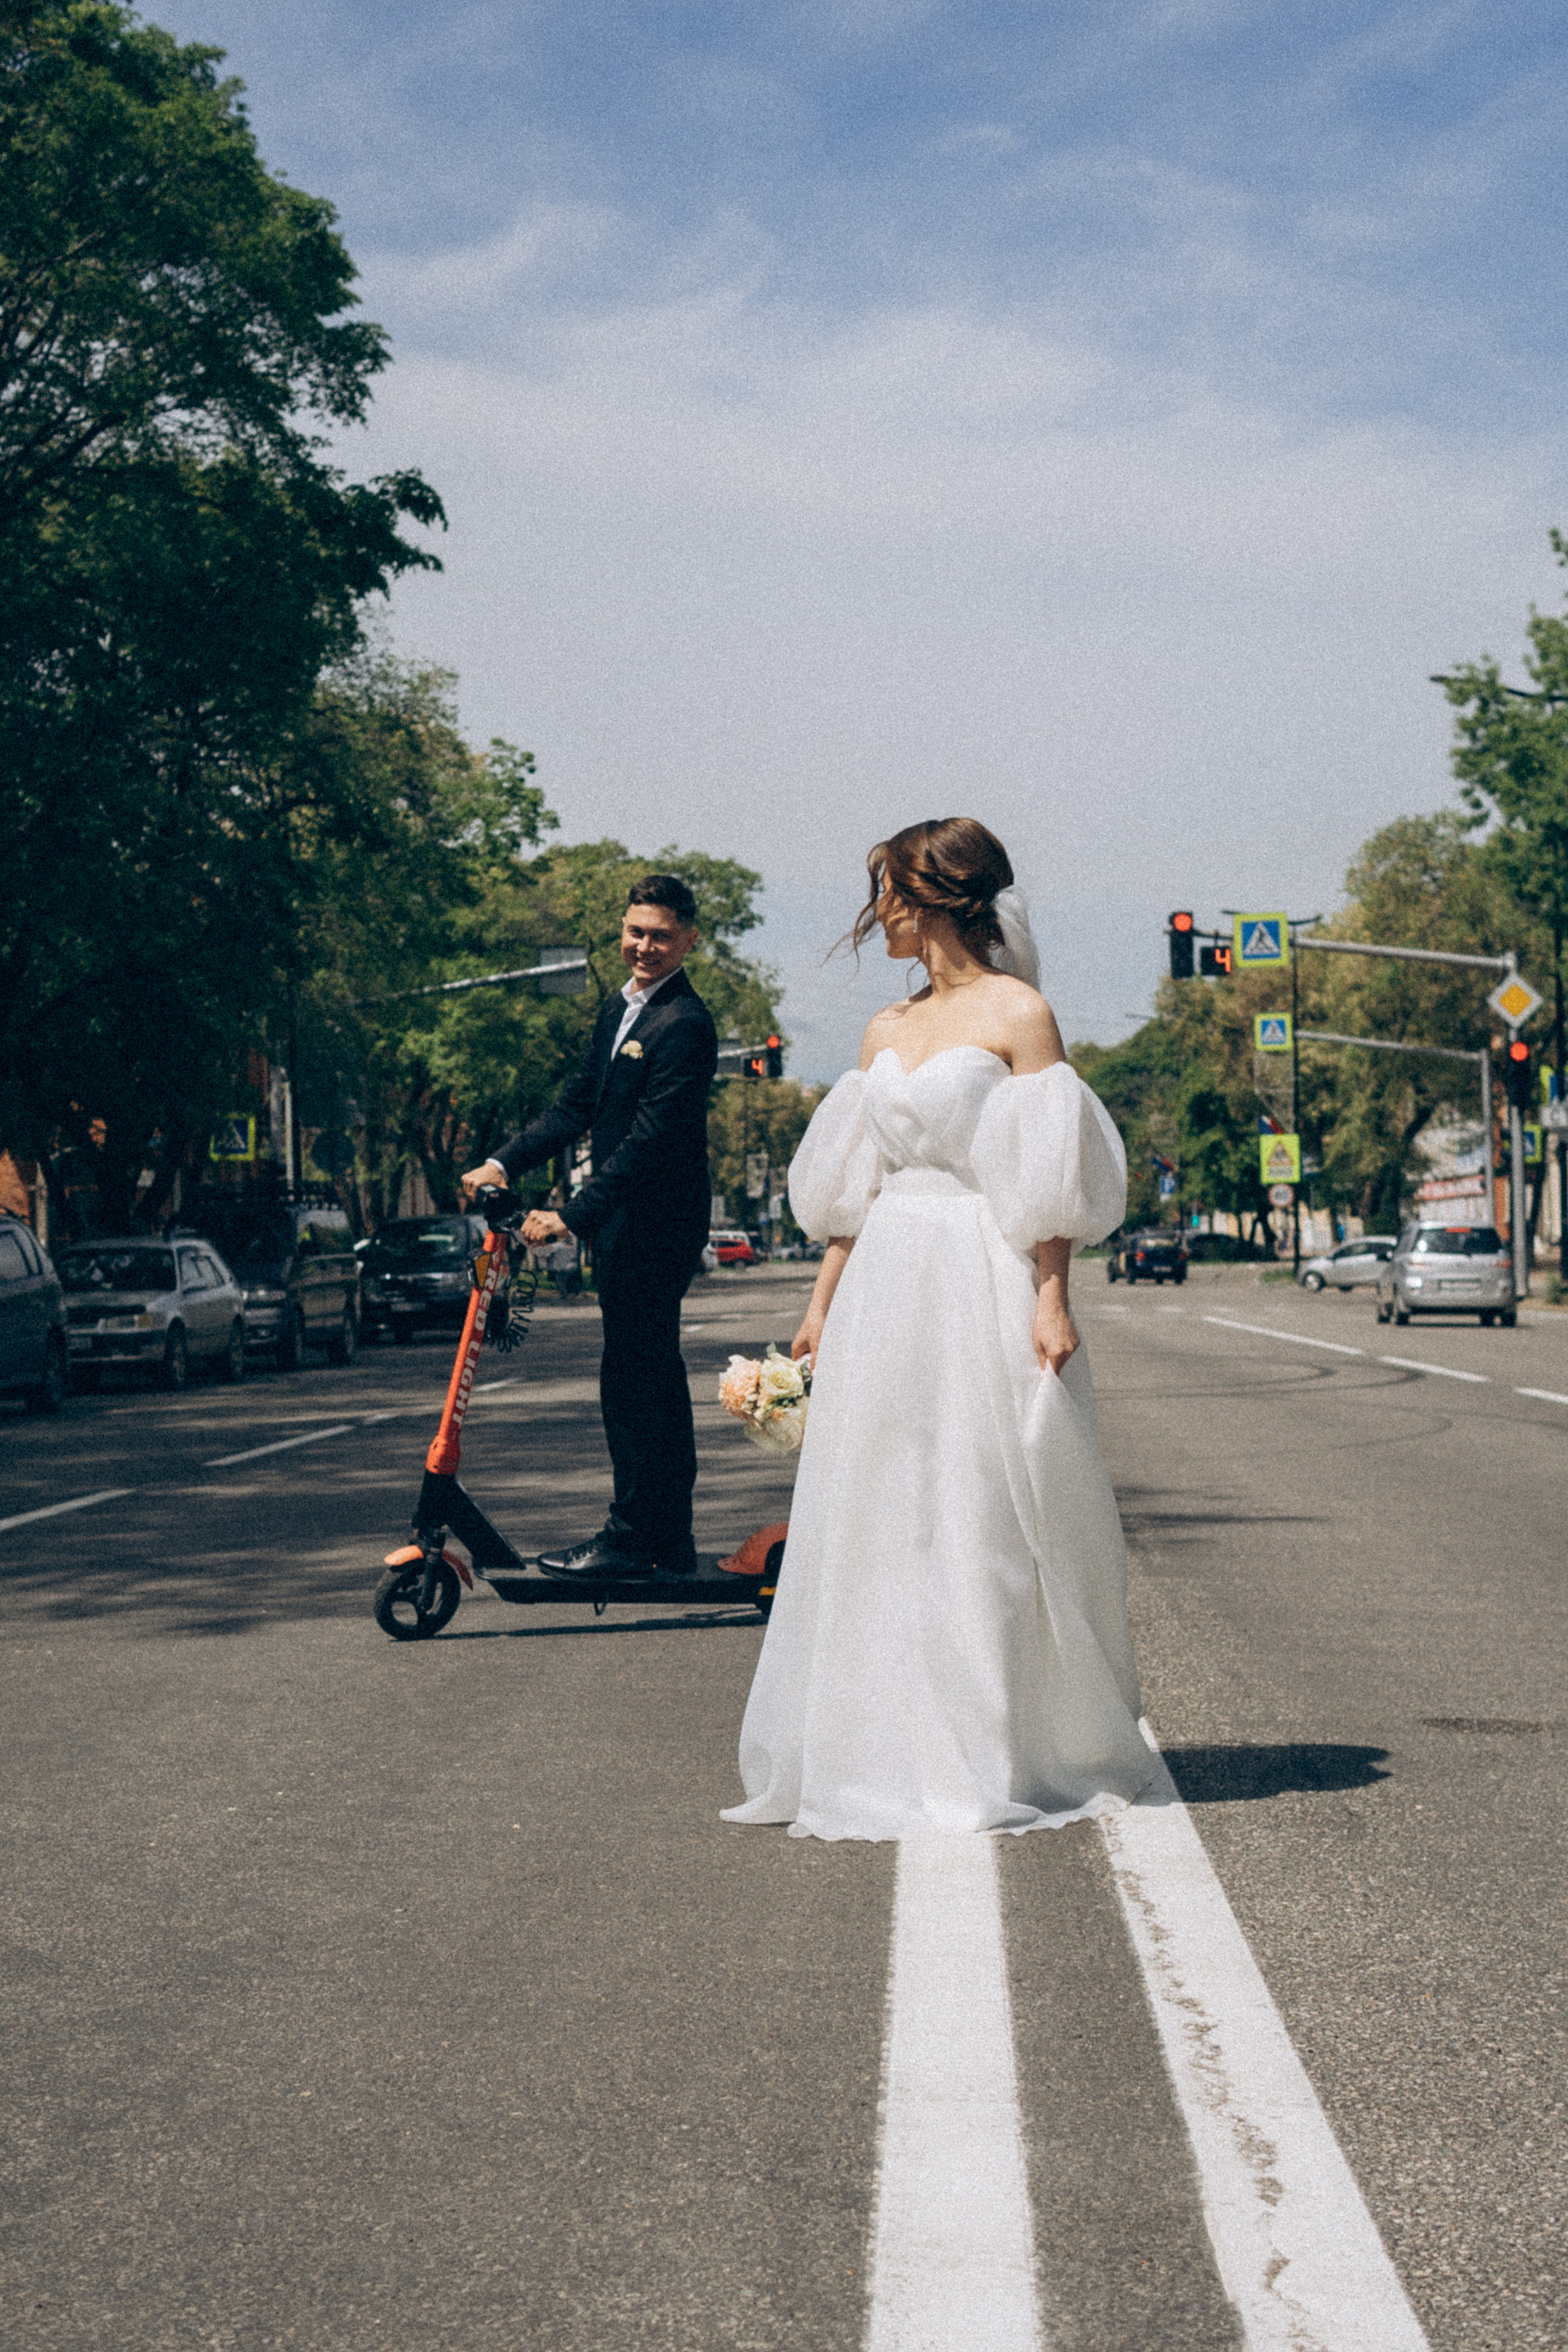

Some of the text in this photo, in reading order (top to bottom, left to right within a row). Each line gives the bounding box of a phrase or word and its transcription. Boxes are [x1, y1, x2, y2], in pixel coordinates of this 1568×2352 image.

[1214, 947, 1231, 973] 4
[752, 1059, 763, 1075] 4
[452, 1267, 498, 1428] RED LIGHT
